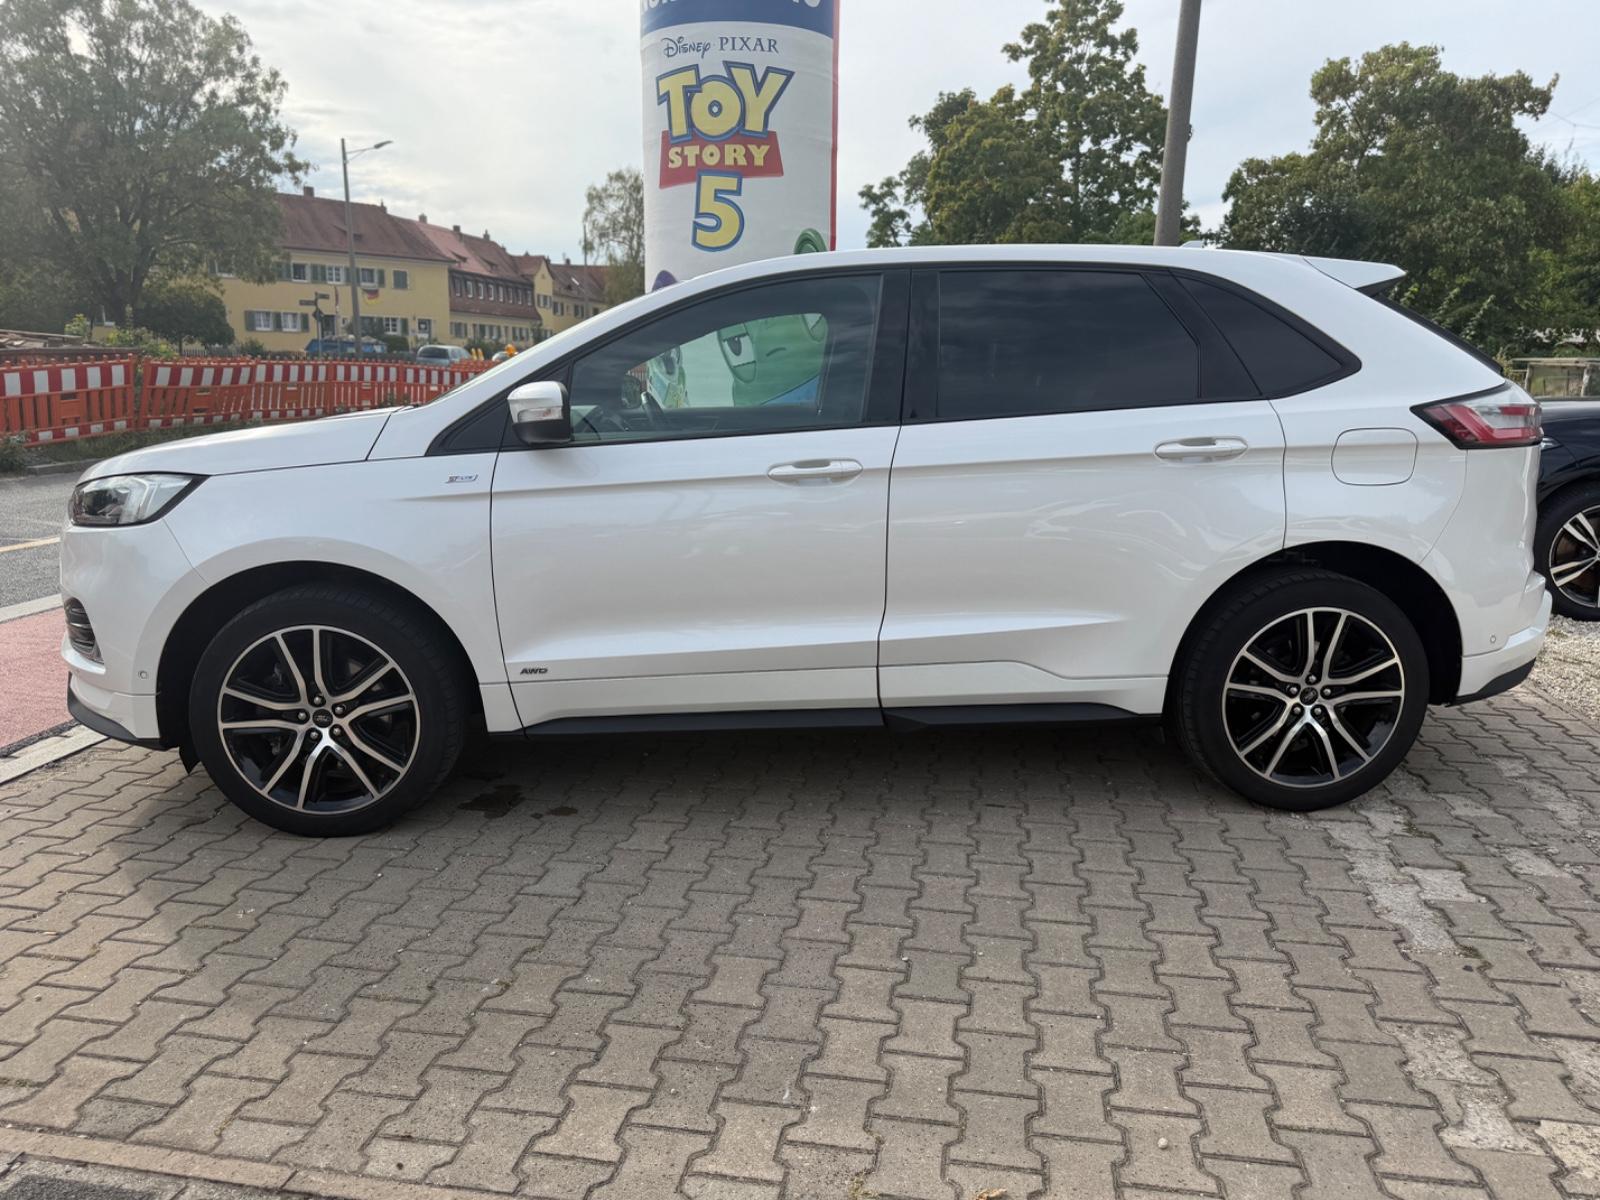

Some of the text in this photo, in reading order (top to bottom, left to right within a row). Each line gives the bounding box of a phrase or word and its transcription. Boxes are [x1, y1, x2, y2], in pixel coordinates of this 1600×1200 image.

[719, 37, 779, 54] PIXAR
[656, 61, 795, 141] TOY
[668, 144, 770, 169] STORY
[692, 171, 745, 252] 5
[520, 667, 548, 675] AWD
